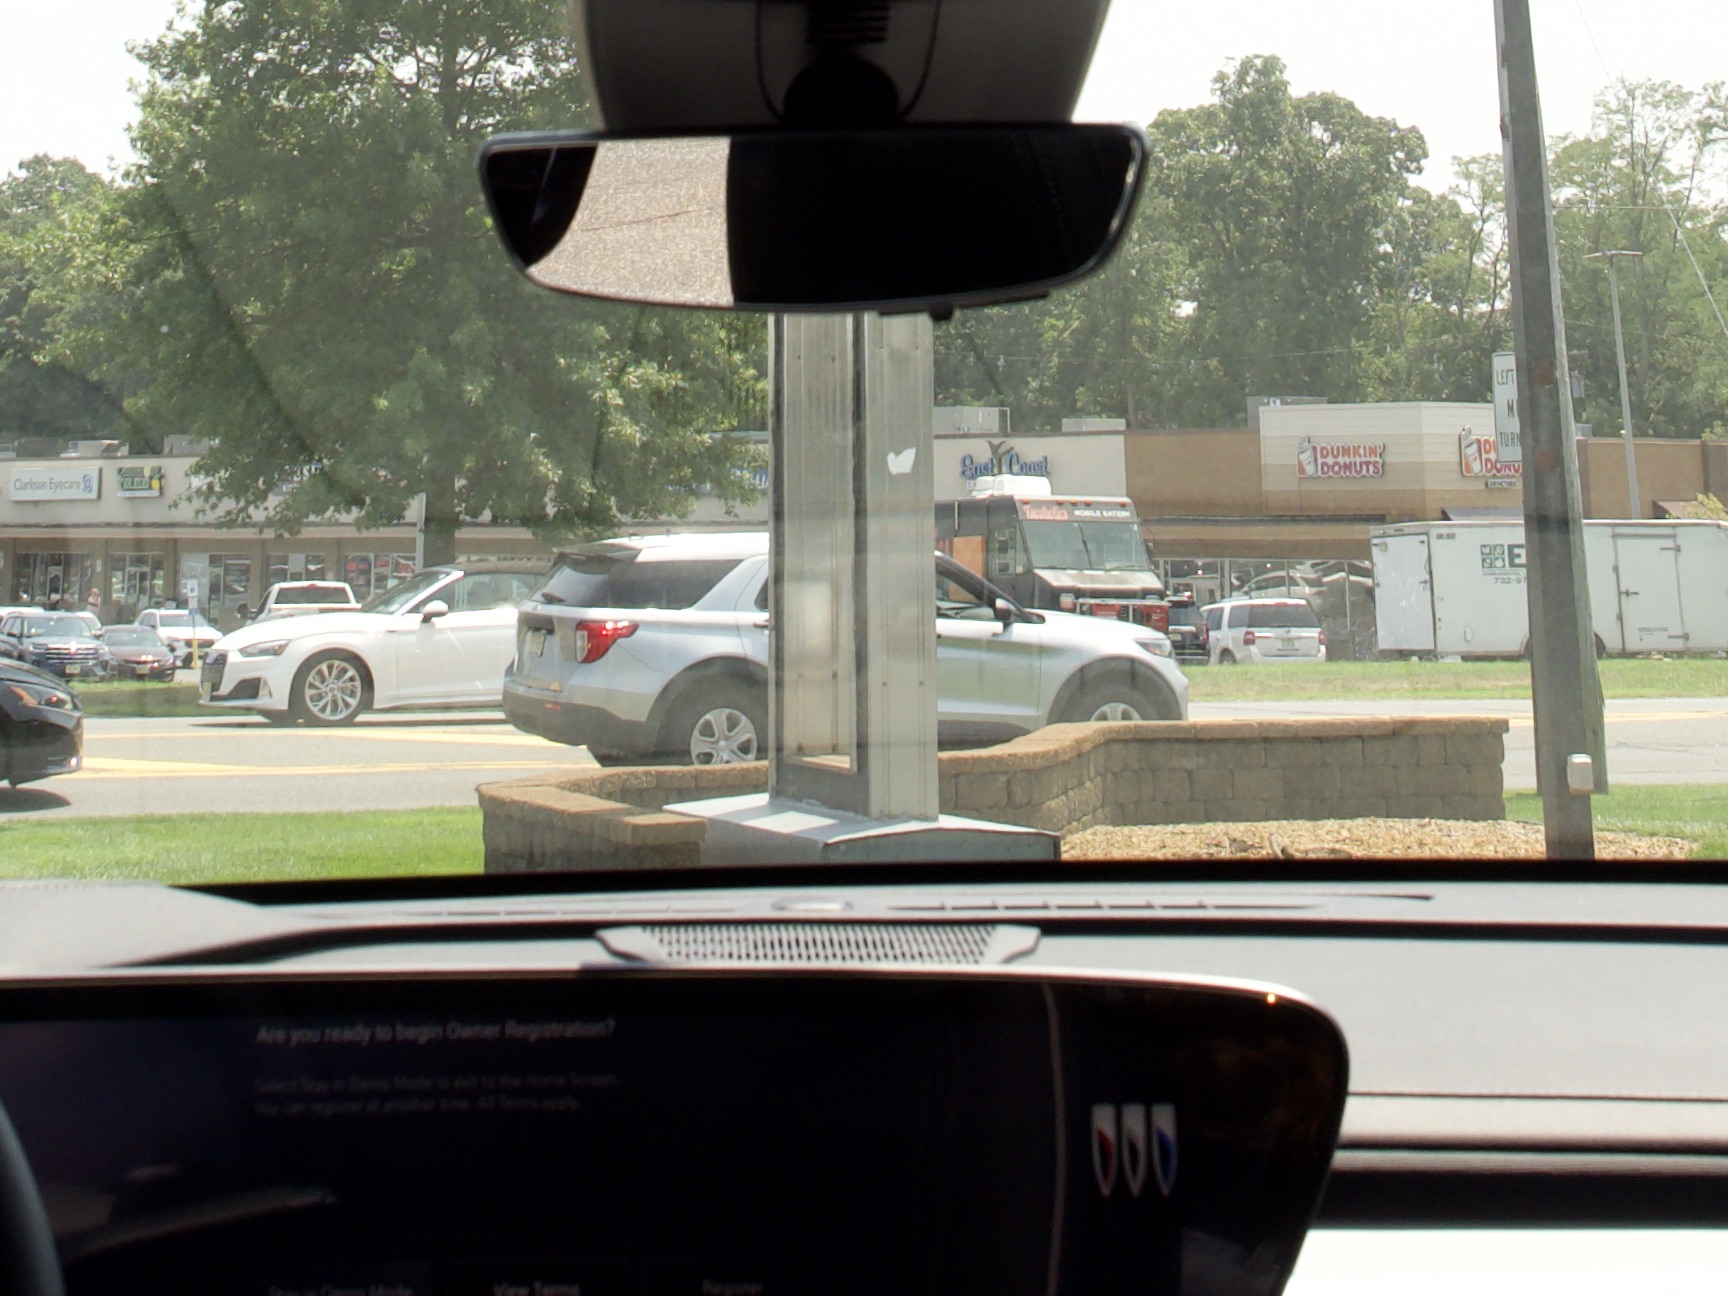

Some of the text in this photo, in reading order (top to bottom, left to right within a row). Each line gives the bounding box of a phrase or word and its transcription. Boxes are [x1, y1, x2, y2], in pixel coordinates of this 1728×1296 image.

[1497, 369, 1515, 385] LEFT
[1319, 443, 1384, 459] DUNKIN'
[959, 450, 1050, 480] East Coast
[1320, 460, 1381, 476] DONUTS
[1484, 458, 1521, 475] DONU
[13, 477, 47, 490] Clarkson
[48, 477, 81, 493] Eyecare
[256, 1018, 616, 1046] Are you ready to begin Owner Registration?
